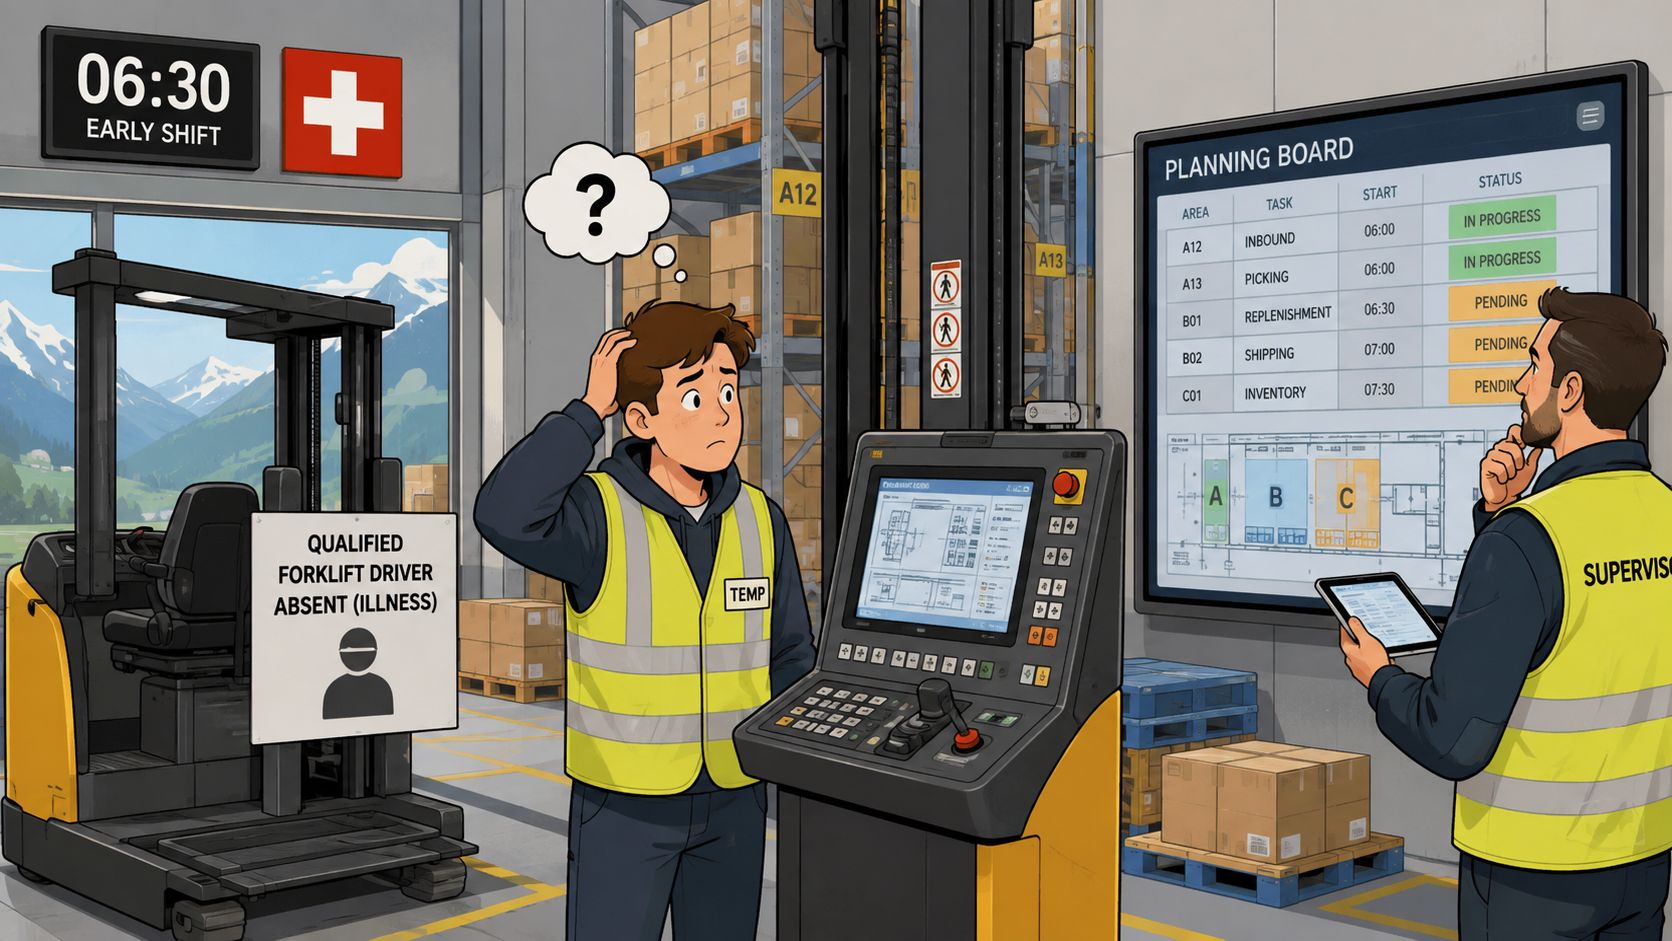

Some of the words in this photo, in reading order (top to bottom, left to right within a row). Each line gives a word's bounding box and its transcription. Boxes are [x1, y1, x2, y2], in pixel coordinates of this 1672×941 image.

[77, 52, 230, 113] 06:30
[87, 117, 155, 142] EARLY
[161, 122, 222, 146] SHIFT
[1165, 147, 1270, 181] PLANNING
[1278, 136, 1354, 167] BOARD
[1478, 171, 1523, 189] STATUS
[779, 181, 817, 207] A12
[1362, 184, 1398, 201] START
[575, 172, 616, 237] ?
[1265, 196, 1293, 211] TASK
[1182, 206, 1210, 220] AREA
[1464, 214, 1476, 229] IN
[1479, 208, 1541, 227] PROGRESS
[1364, 222, 1395, 238] 06:00
[1182, 240, 1202, 254] A12
[1245, 231, 1296, 249] INBOUND
[1038, 251, 1064, 269] A13
[1464, 255, 1476, 269] IN
[1479, 250, 1542, 268] PROGRESS
[1364, 261, 1395, 276] 06:00
[1182, 277, 1202, 291] A13
[1245, 270, 1289, 286] PICKING
[1364, 301, 1395, 316] 06:30
[1475, 293, 1528, 310] PENDING
[1182, 314, 1201, 328] B01
[1245, 305, 1332, 324] REPLENISHMENT
[1364, 342, 1395, 356] 07:00
[1475, 335, 1528, 352] PENDING
[1182, 351, 1203, 365] B02
[1244, 346, 1295, 362] SHIPPING
[1182, 389, 1201, 403] C01
[1245, 385, 1307, 400] INVENTORY
[1364, 382, 1395, 397] 07:30
[1208, 485, 1223, 506] A
[1269, 486, 1283, 508] B
[1339, 487, 1354, 509] C
[307, 533, 404, 555] QUALIFIED
[278, 564, 365, 585] FORKLIFT
[370, 563, 434, 583] DRIVER
[729, 586, 766, 602] TEMP
[273, 594, 349, 616] ABSENT
[353, 591, 438, 617] (ILLNESS)
